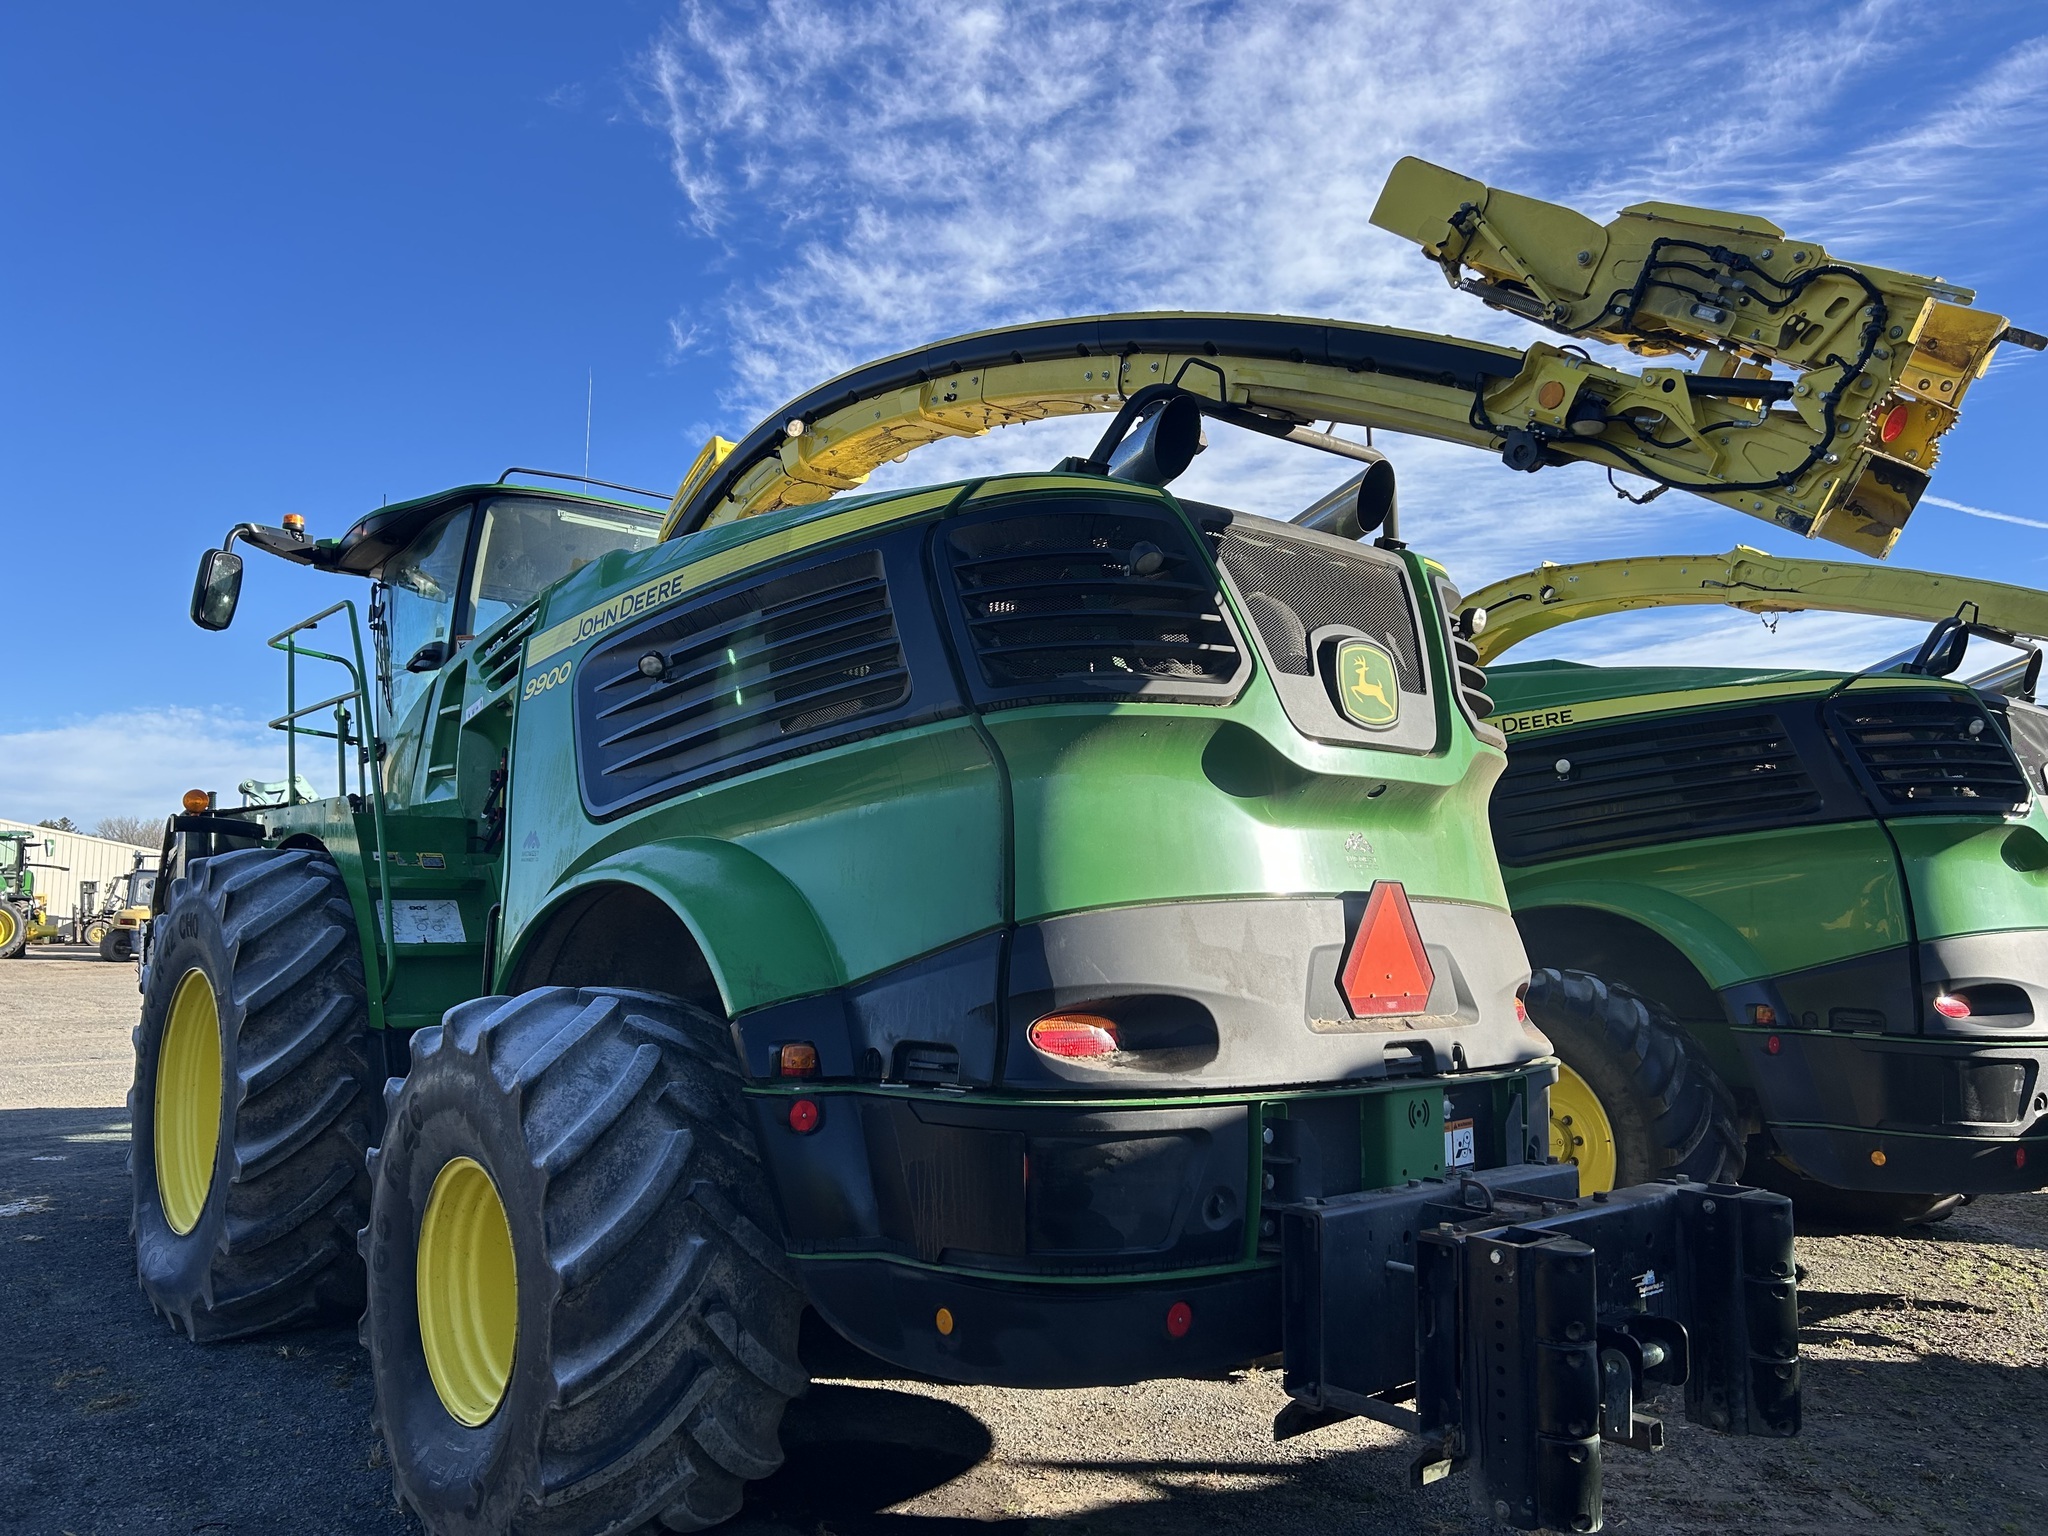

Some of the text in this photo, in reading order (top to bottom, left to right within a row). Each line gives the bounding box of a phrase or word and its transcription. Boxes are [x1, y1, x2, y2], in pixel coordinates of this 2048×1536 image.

[572, 575, 684, 642] JOHN DEERE
[523, 660, 572, 701] 9900
[1502, 709, 1574, 734] DEERE
